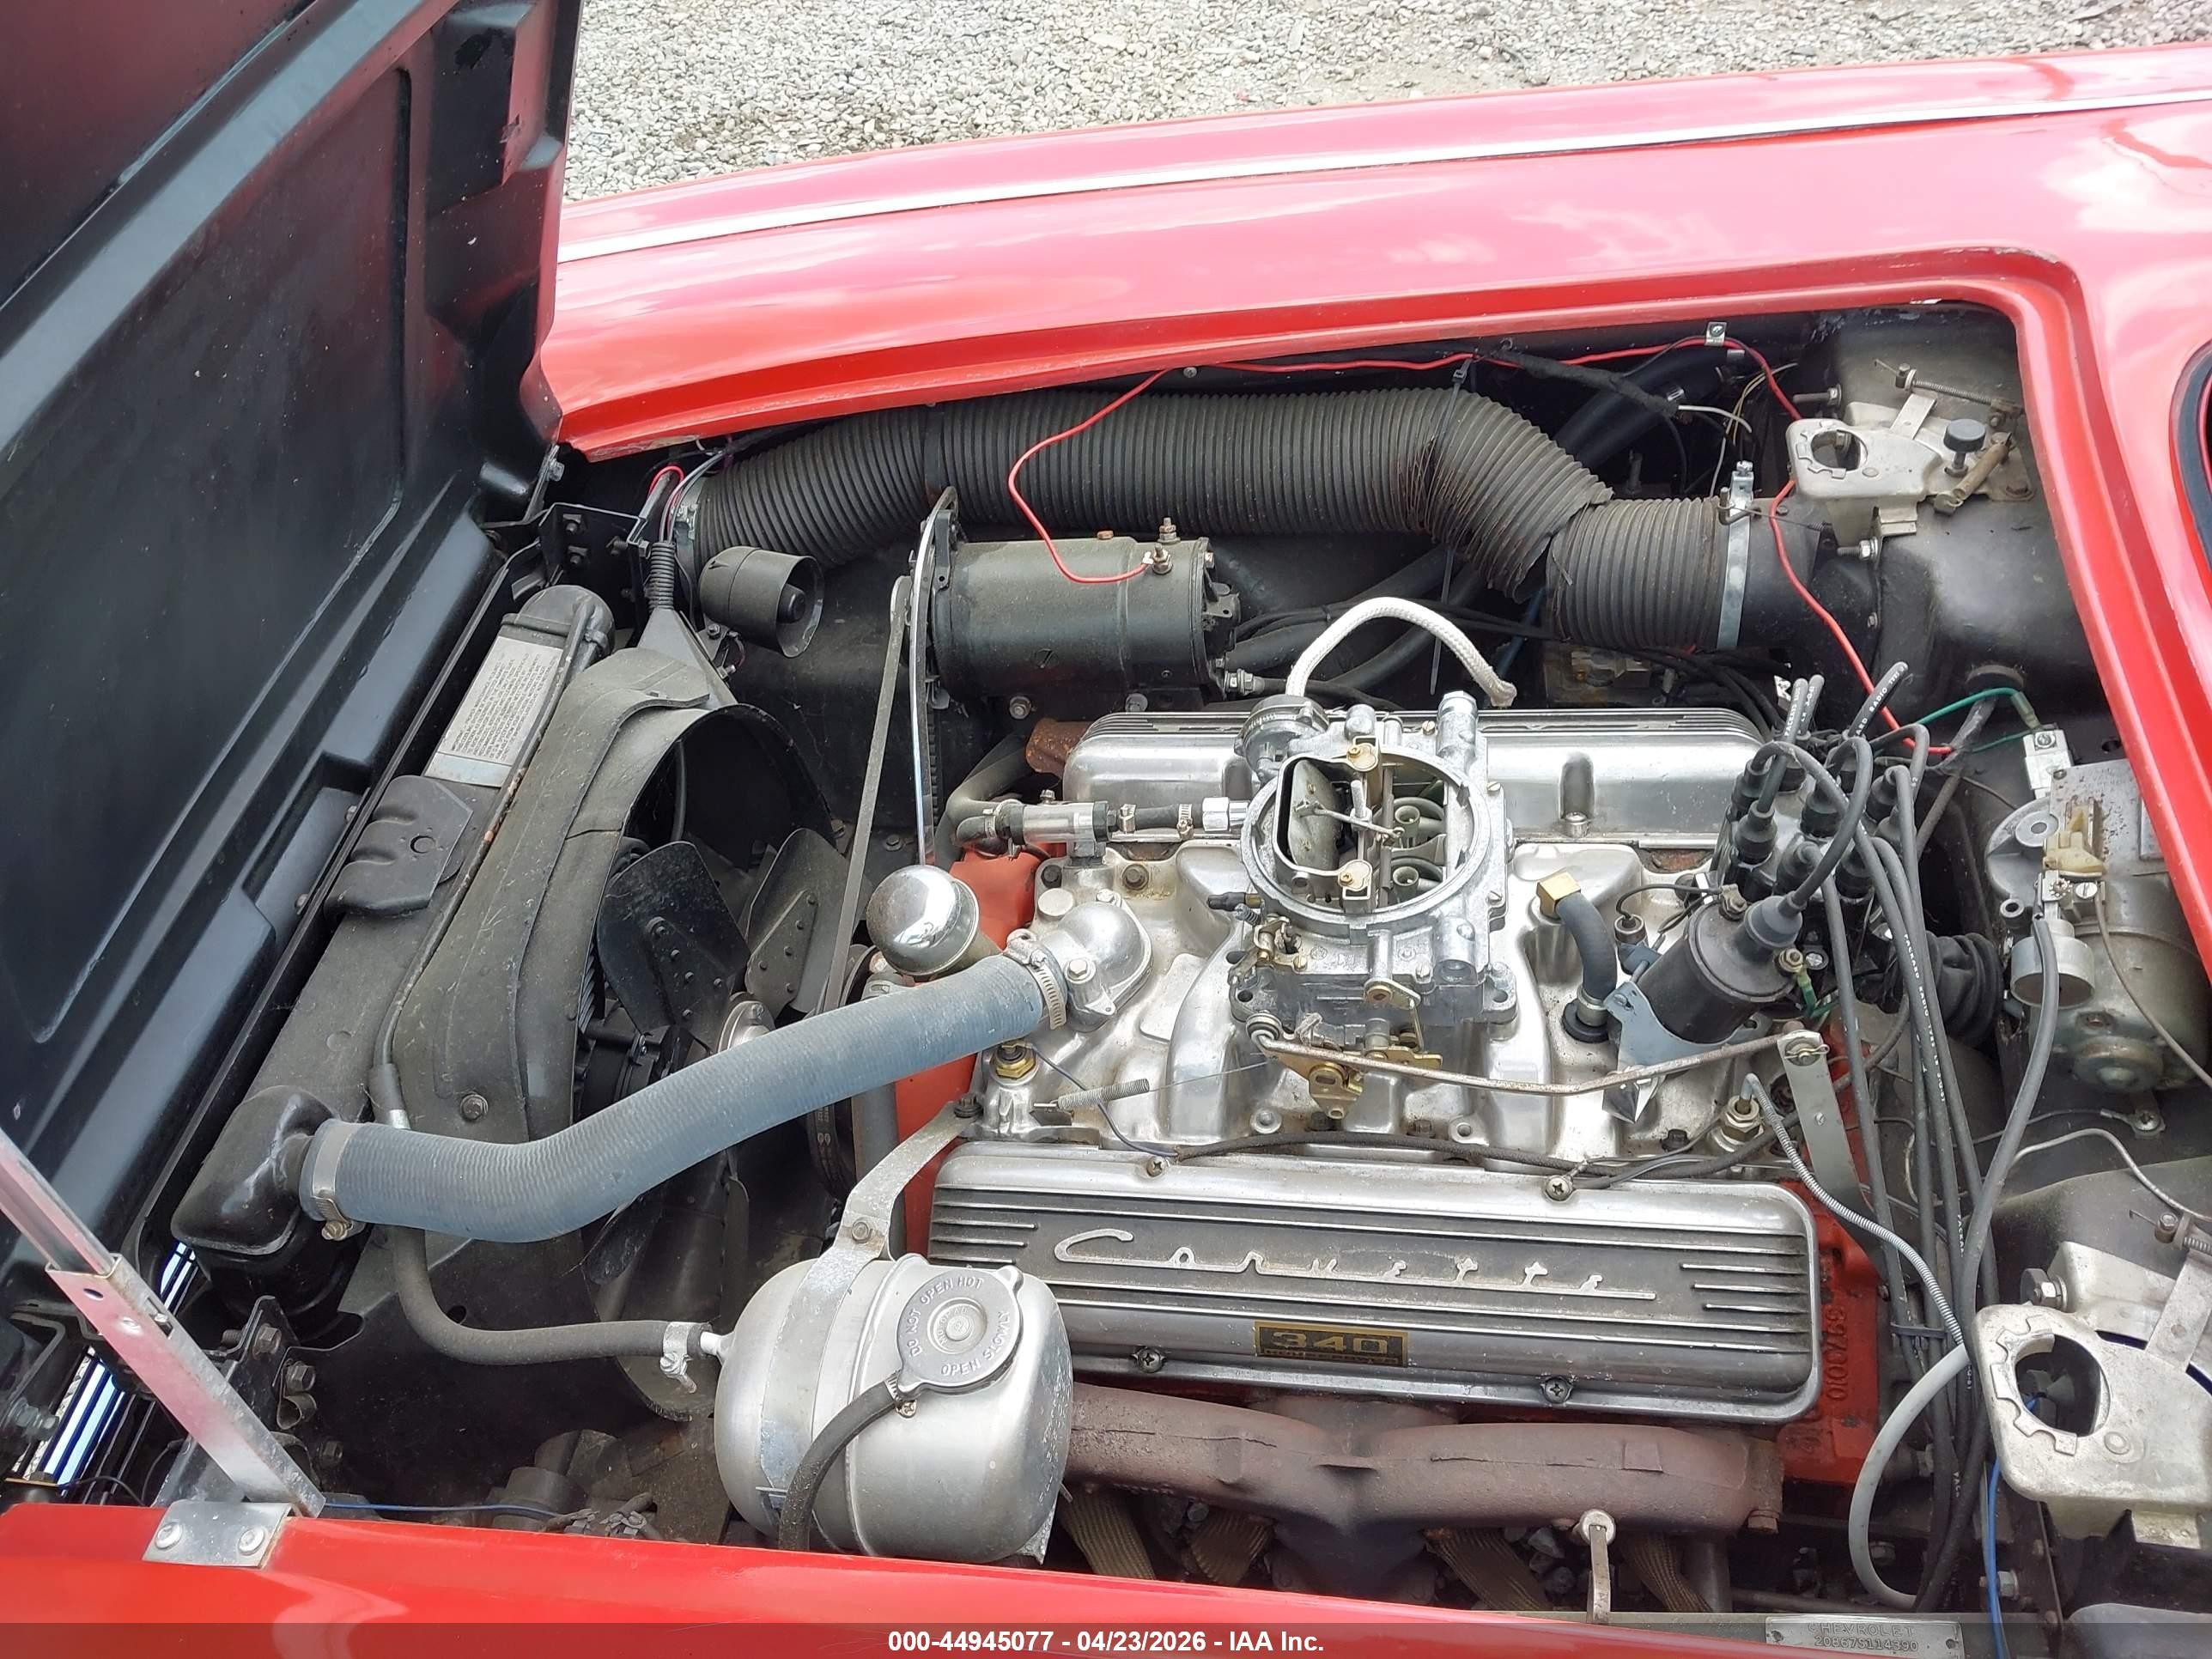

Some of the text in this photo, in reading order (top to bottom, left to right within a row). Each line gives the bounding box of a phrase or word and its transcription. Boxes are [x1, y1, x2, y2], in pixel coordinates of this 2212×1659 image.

[1869, 687, 1887, 713] RADIO
[1904, 933, 1920, 979] PACKARD
[1918, 986, 1929, 1017] RADIO
[906, 1275, 985, 1358] DO NOT OPEN HOT
[940, 1310, 1012, 1376] OPEN SLOWLY
[1272, 1331, 1389, 1355] 340
[1808, 1622, 1915, 1638] CHEVROLET
[1814, 1635, 1919, 1652] 20867S114390
